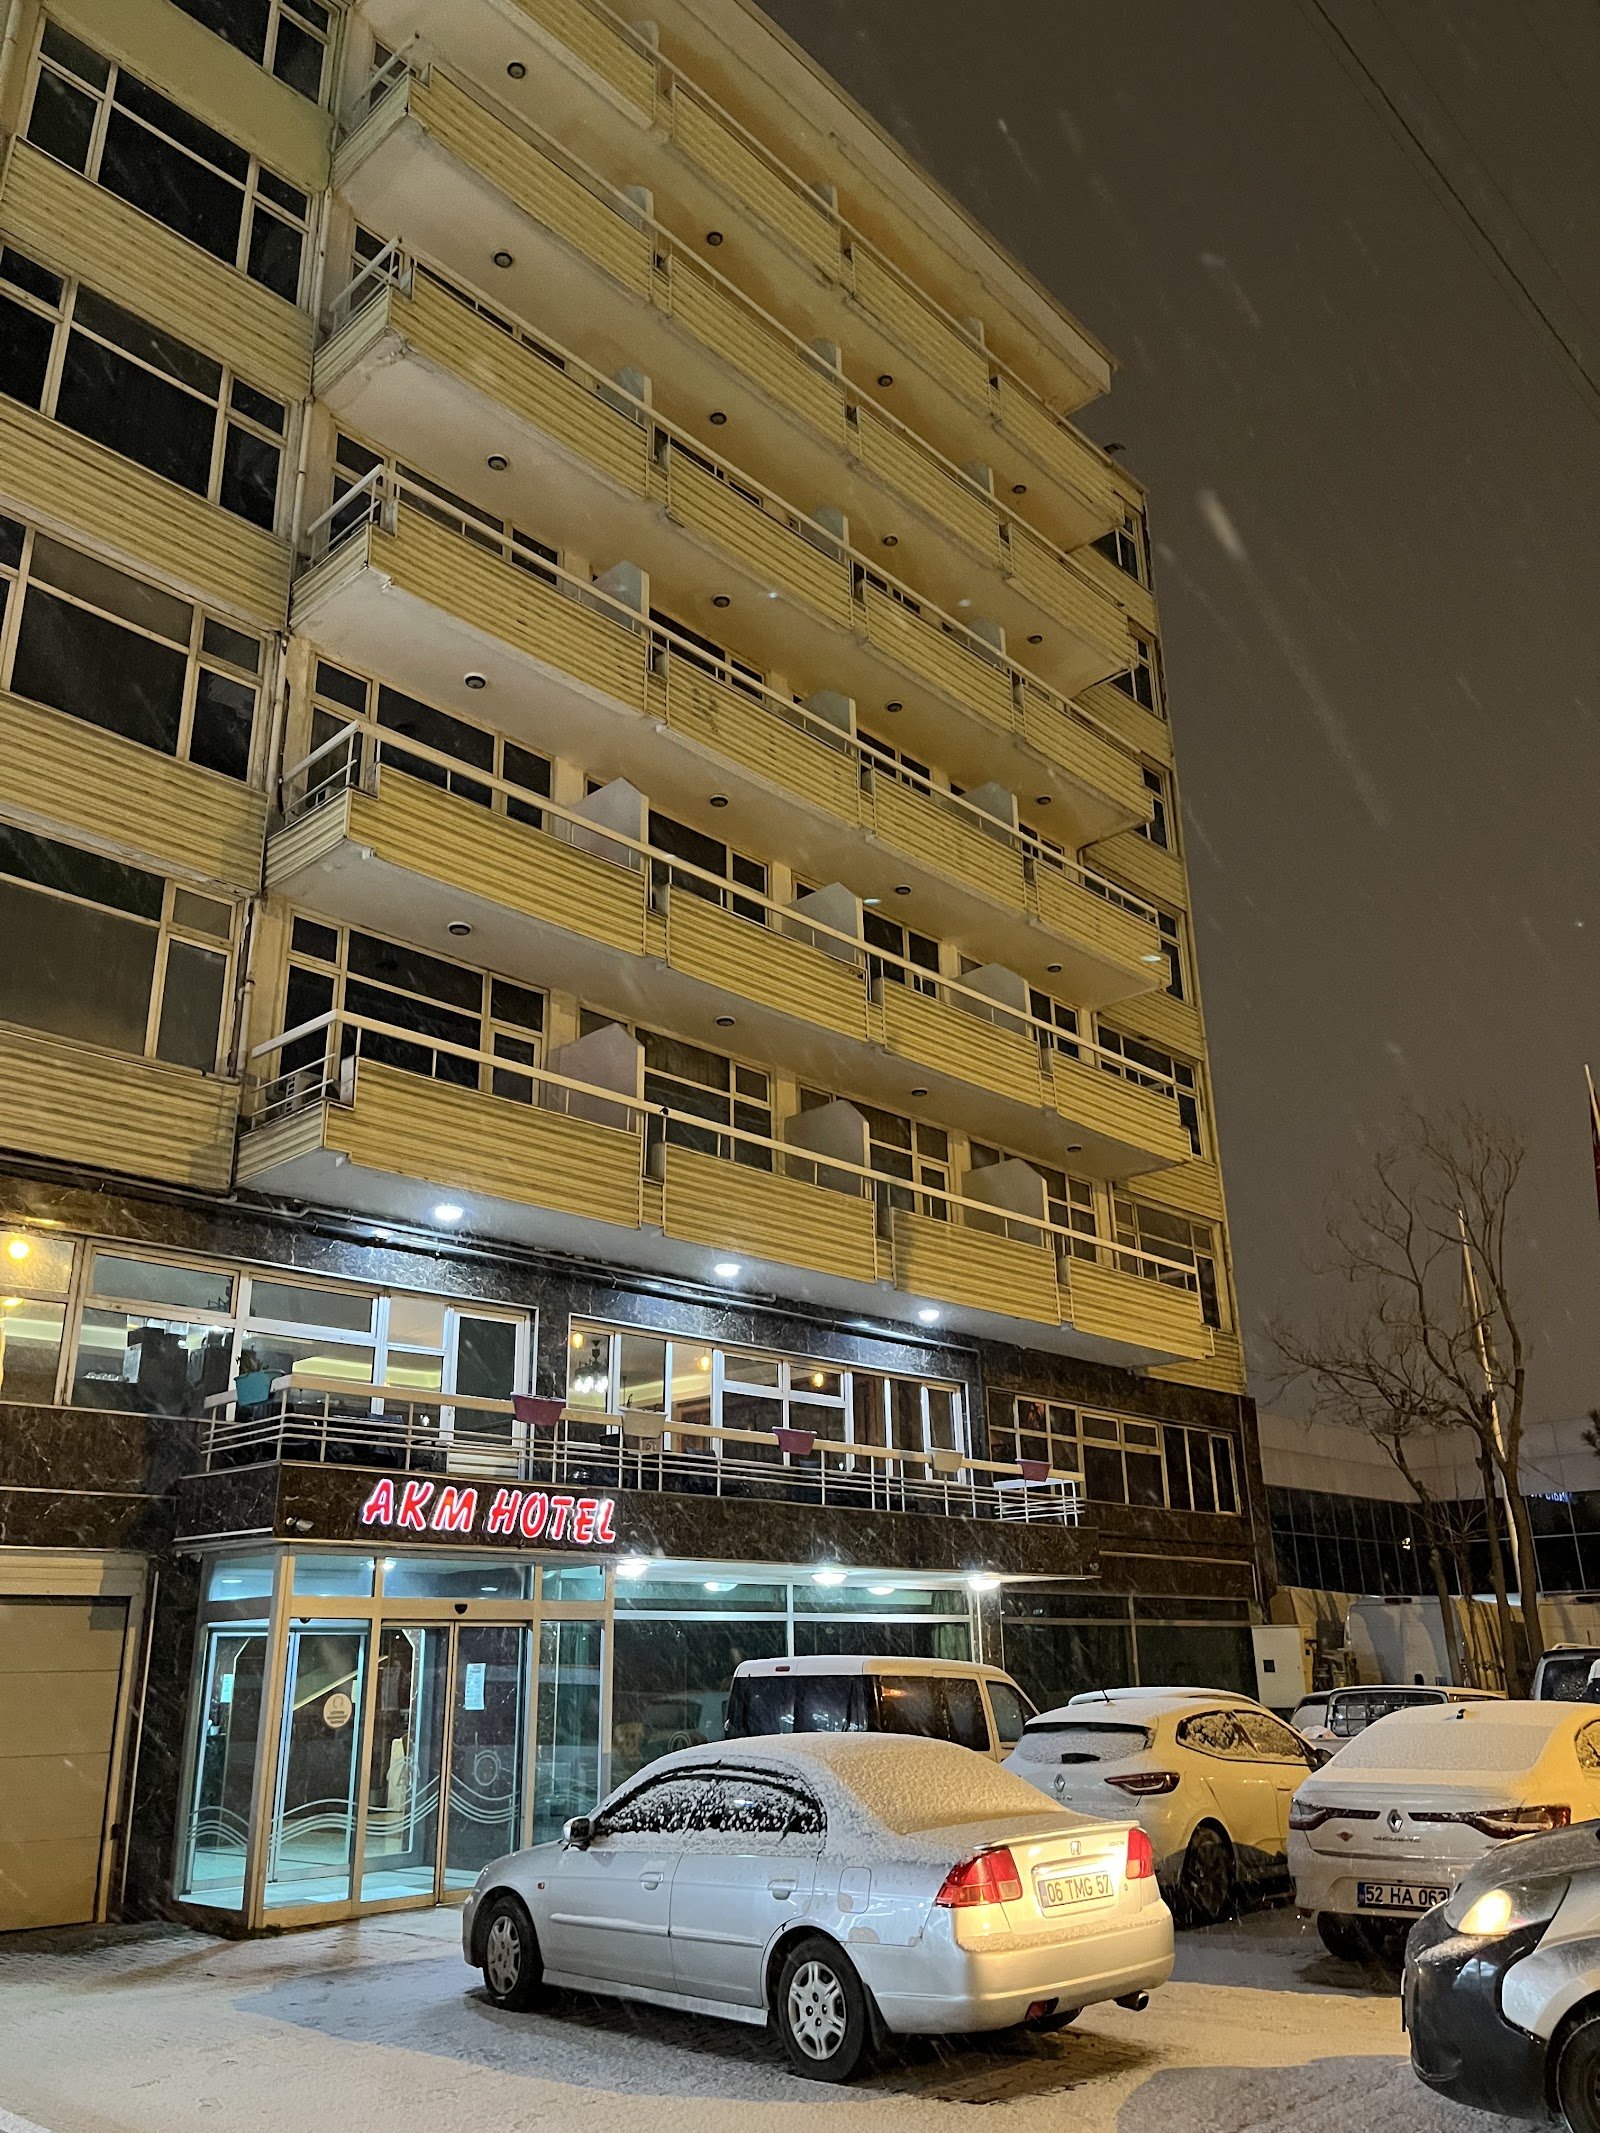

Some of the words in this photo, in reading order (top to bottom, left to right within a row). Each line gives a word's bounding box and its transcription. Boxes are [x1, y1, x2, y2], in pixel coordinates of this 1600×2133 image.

[362, 1478, 477, 1533] AKM
[487, 1488, 616, 1545] HOTEL
[1046, 1881, 1064, 1903] 06
[1065, 1877, 1093, 1900] TMG
[1095, 1874, 1109, 1895] 57
[1365, 1885, 1384, 1903] 52
[1390, 1886, 1414, 1905] HA
